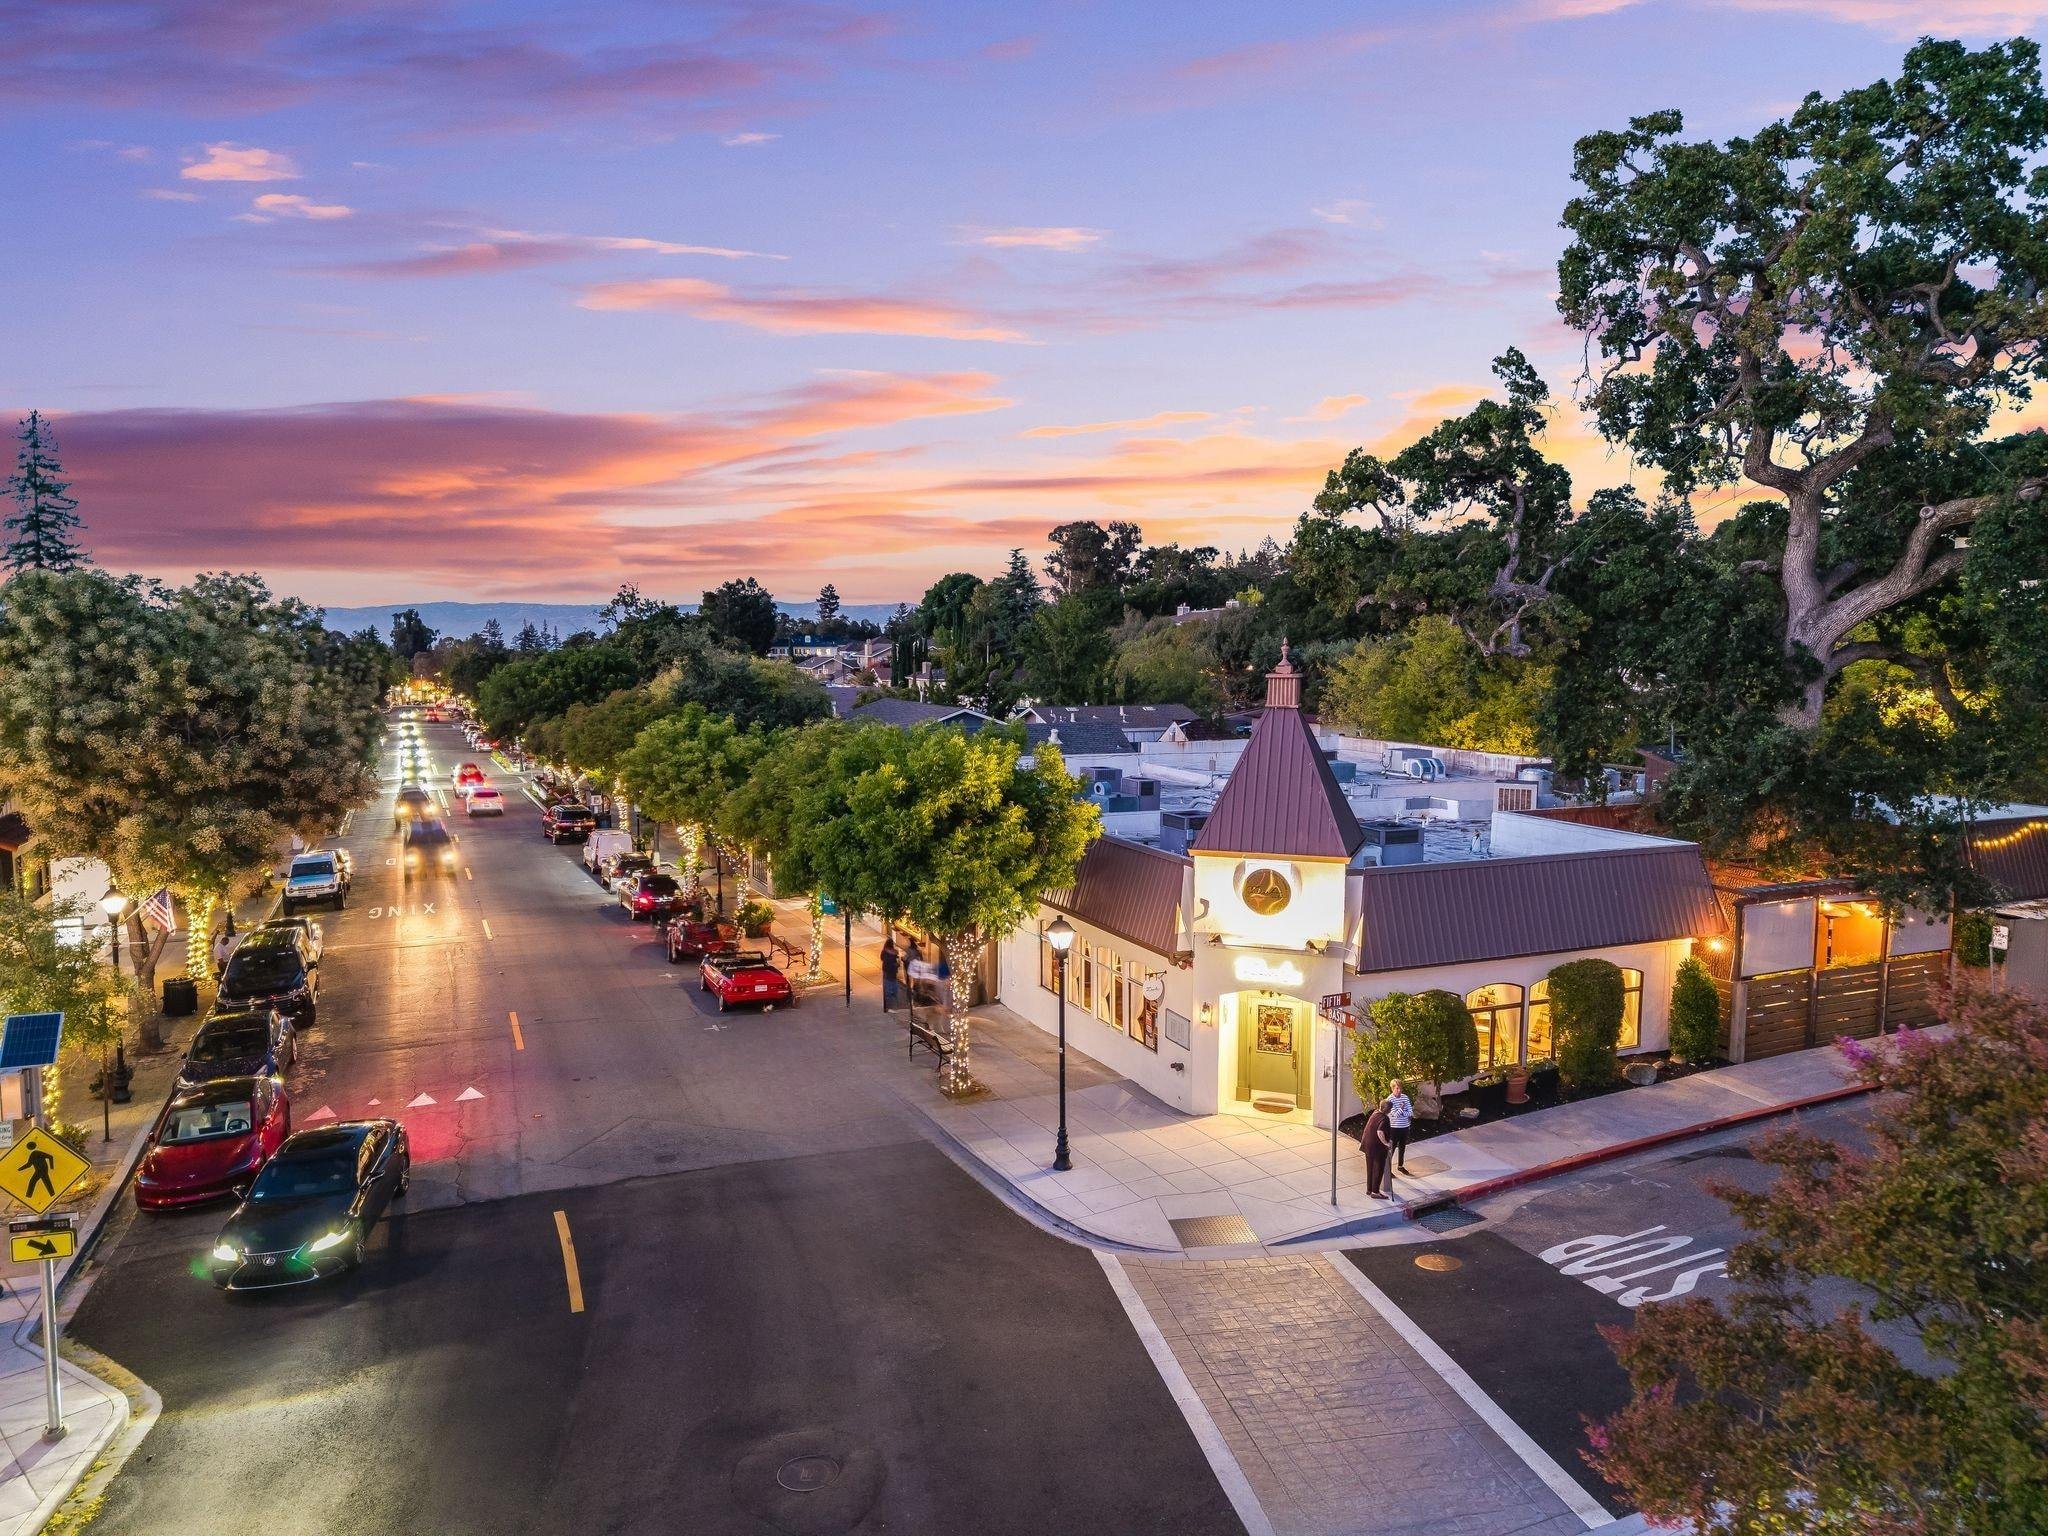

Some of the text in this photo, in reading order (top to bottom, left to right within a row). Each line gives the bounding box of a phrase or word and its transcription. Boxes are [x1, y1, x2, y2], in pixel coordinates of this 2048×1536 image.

[368, 902, 436, 919] XING
[1322, 995, 1341, 1008] FIFTH
[1327, 1009, 1346, 1024] BASIN
[1537, 1225, 1729, 1307] STOP
